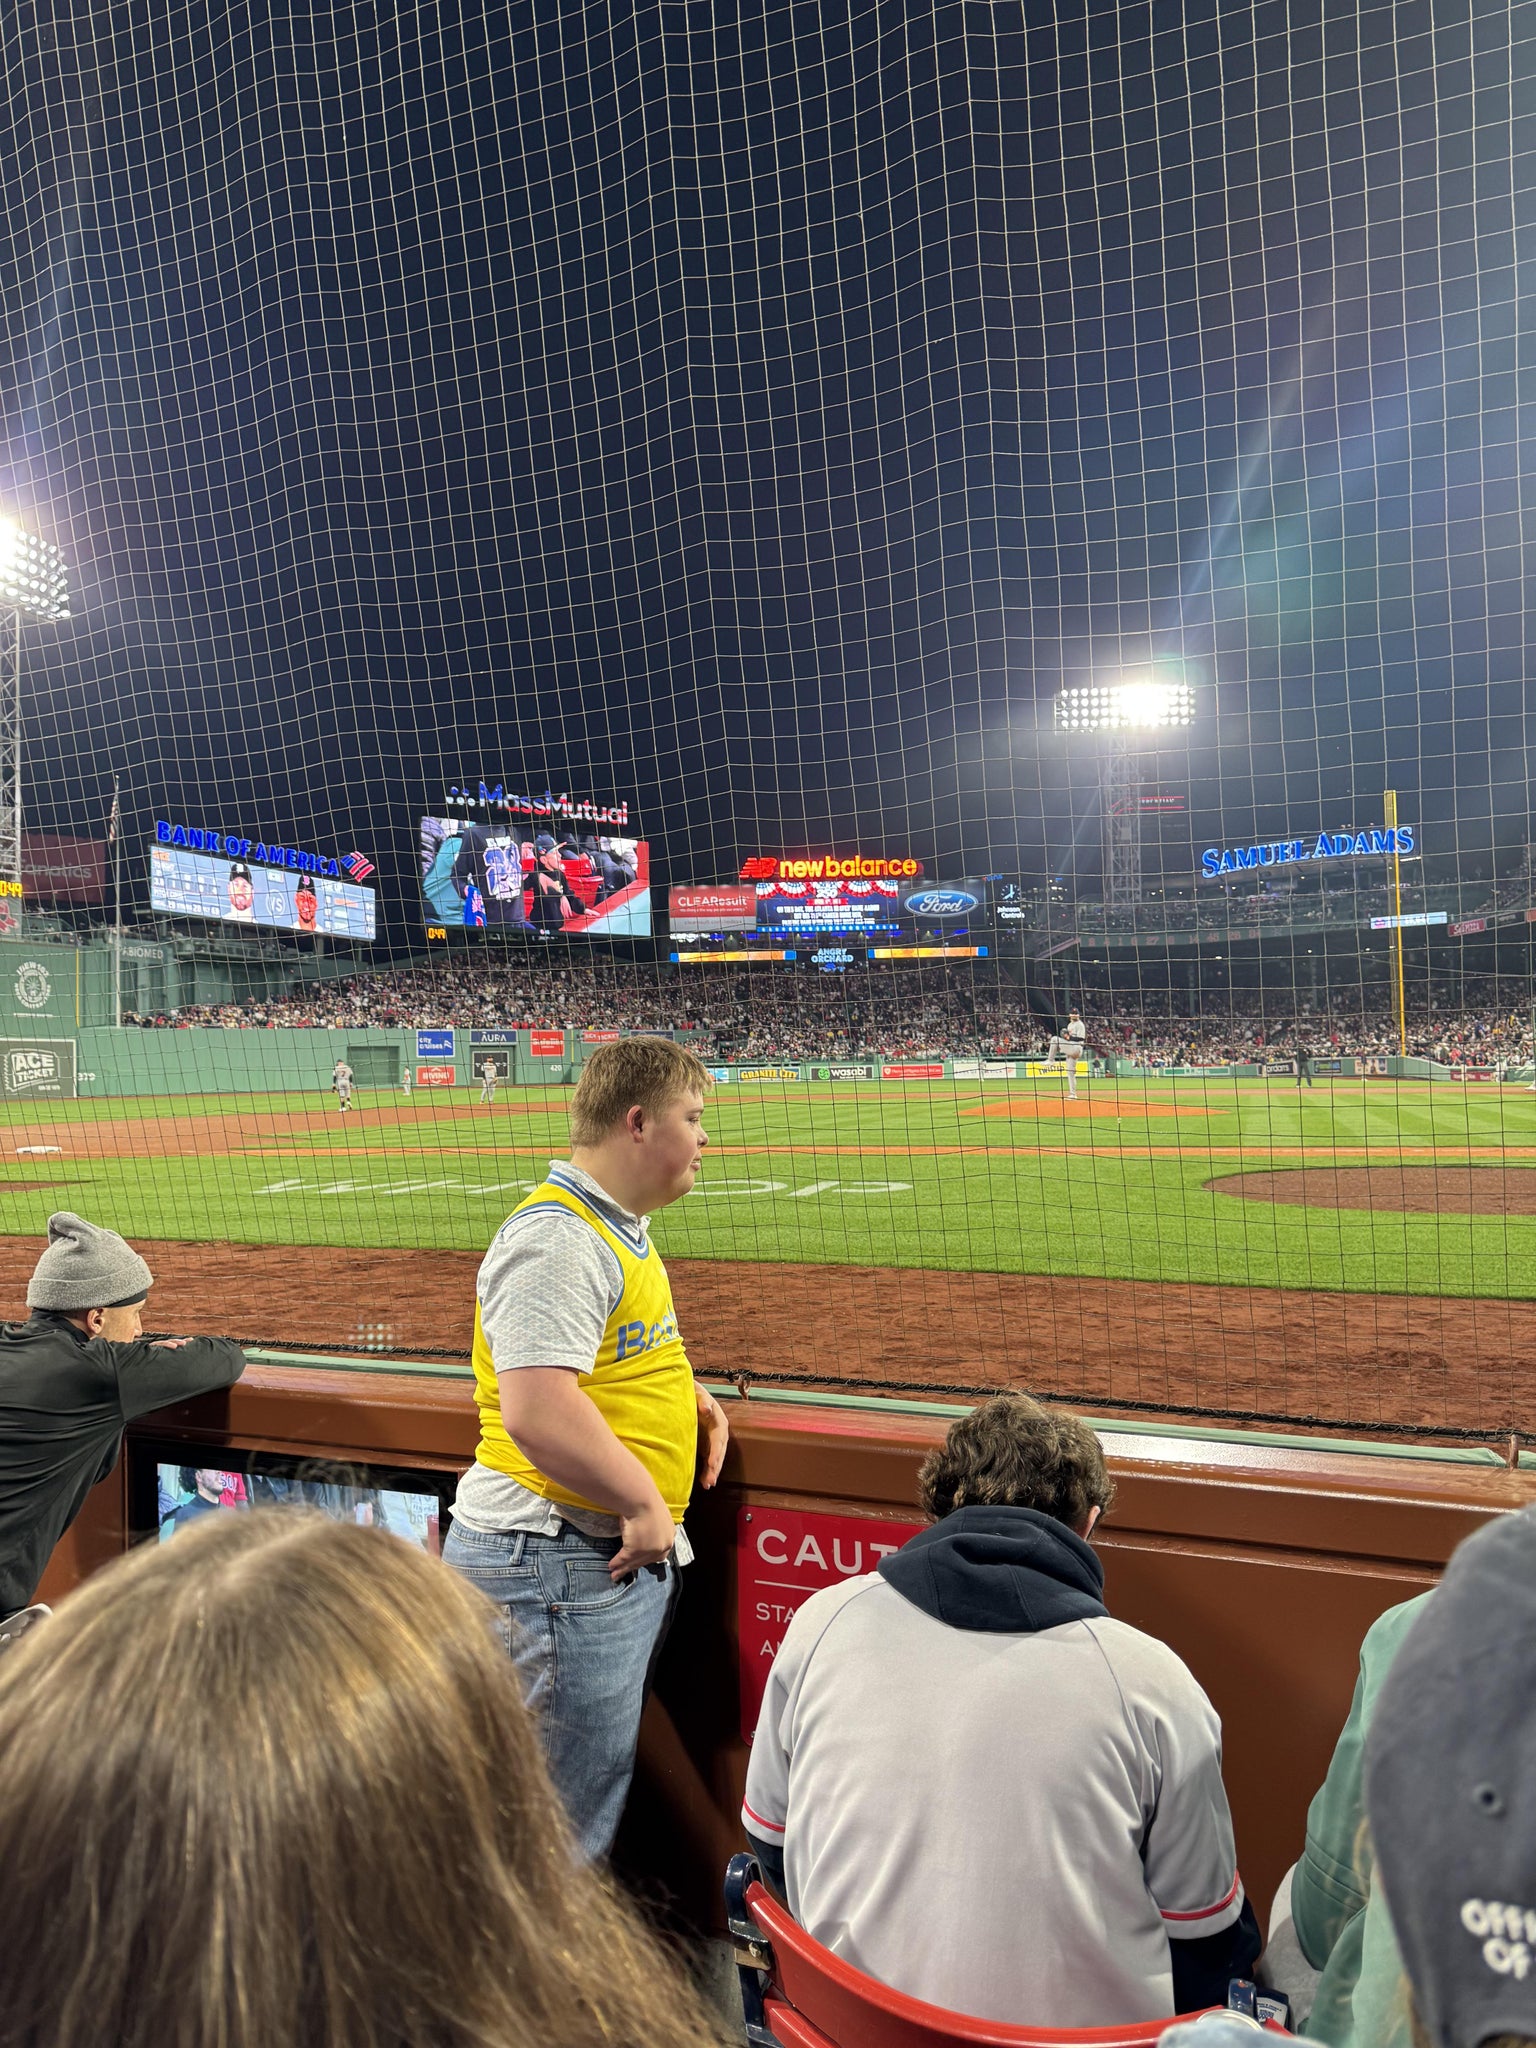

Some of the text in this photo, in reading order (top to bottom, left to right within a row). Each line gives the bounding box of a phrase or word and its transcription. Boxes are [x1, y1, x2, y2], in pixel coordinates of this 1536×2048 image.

[479, 781, 628, 825] MassMutual
[157, 820, 340, 879] BANK OF AMERICA
[1202, 826, 1414, 878] SAMUEL ADAMS
[21, 859, 92, 879] anatics
[267, 897, 284, 912] VS
[678, 896, 746, 907] CLEAResult
[919, 894, 964, 913] Ford
[122, 946, 164, 960] ABIOMED
[810, 954, 854, 963] ORCHARD
[817, 947, 848, 955] ANGRY
[15, 1053, 55, 1071] ACE
[16, 1068, 55, 1083] TICKET
[740, 1068, 799, 1079] GRANITE CITY
[830, 1067, 867, 1077] wasabi
[251, 1178, 914, 1197] WHOP
